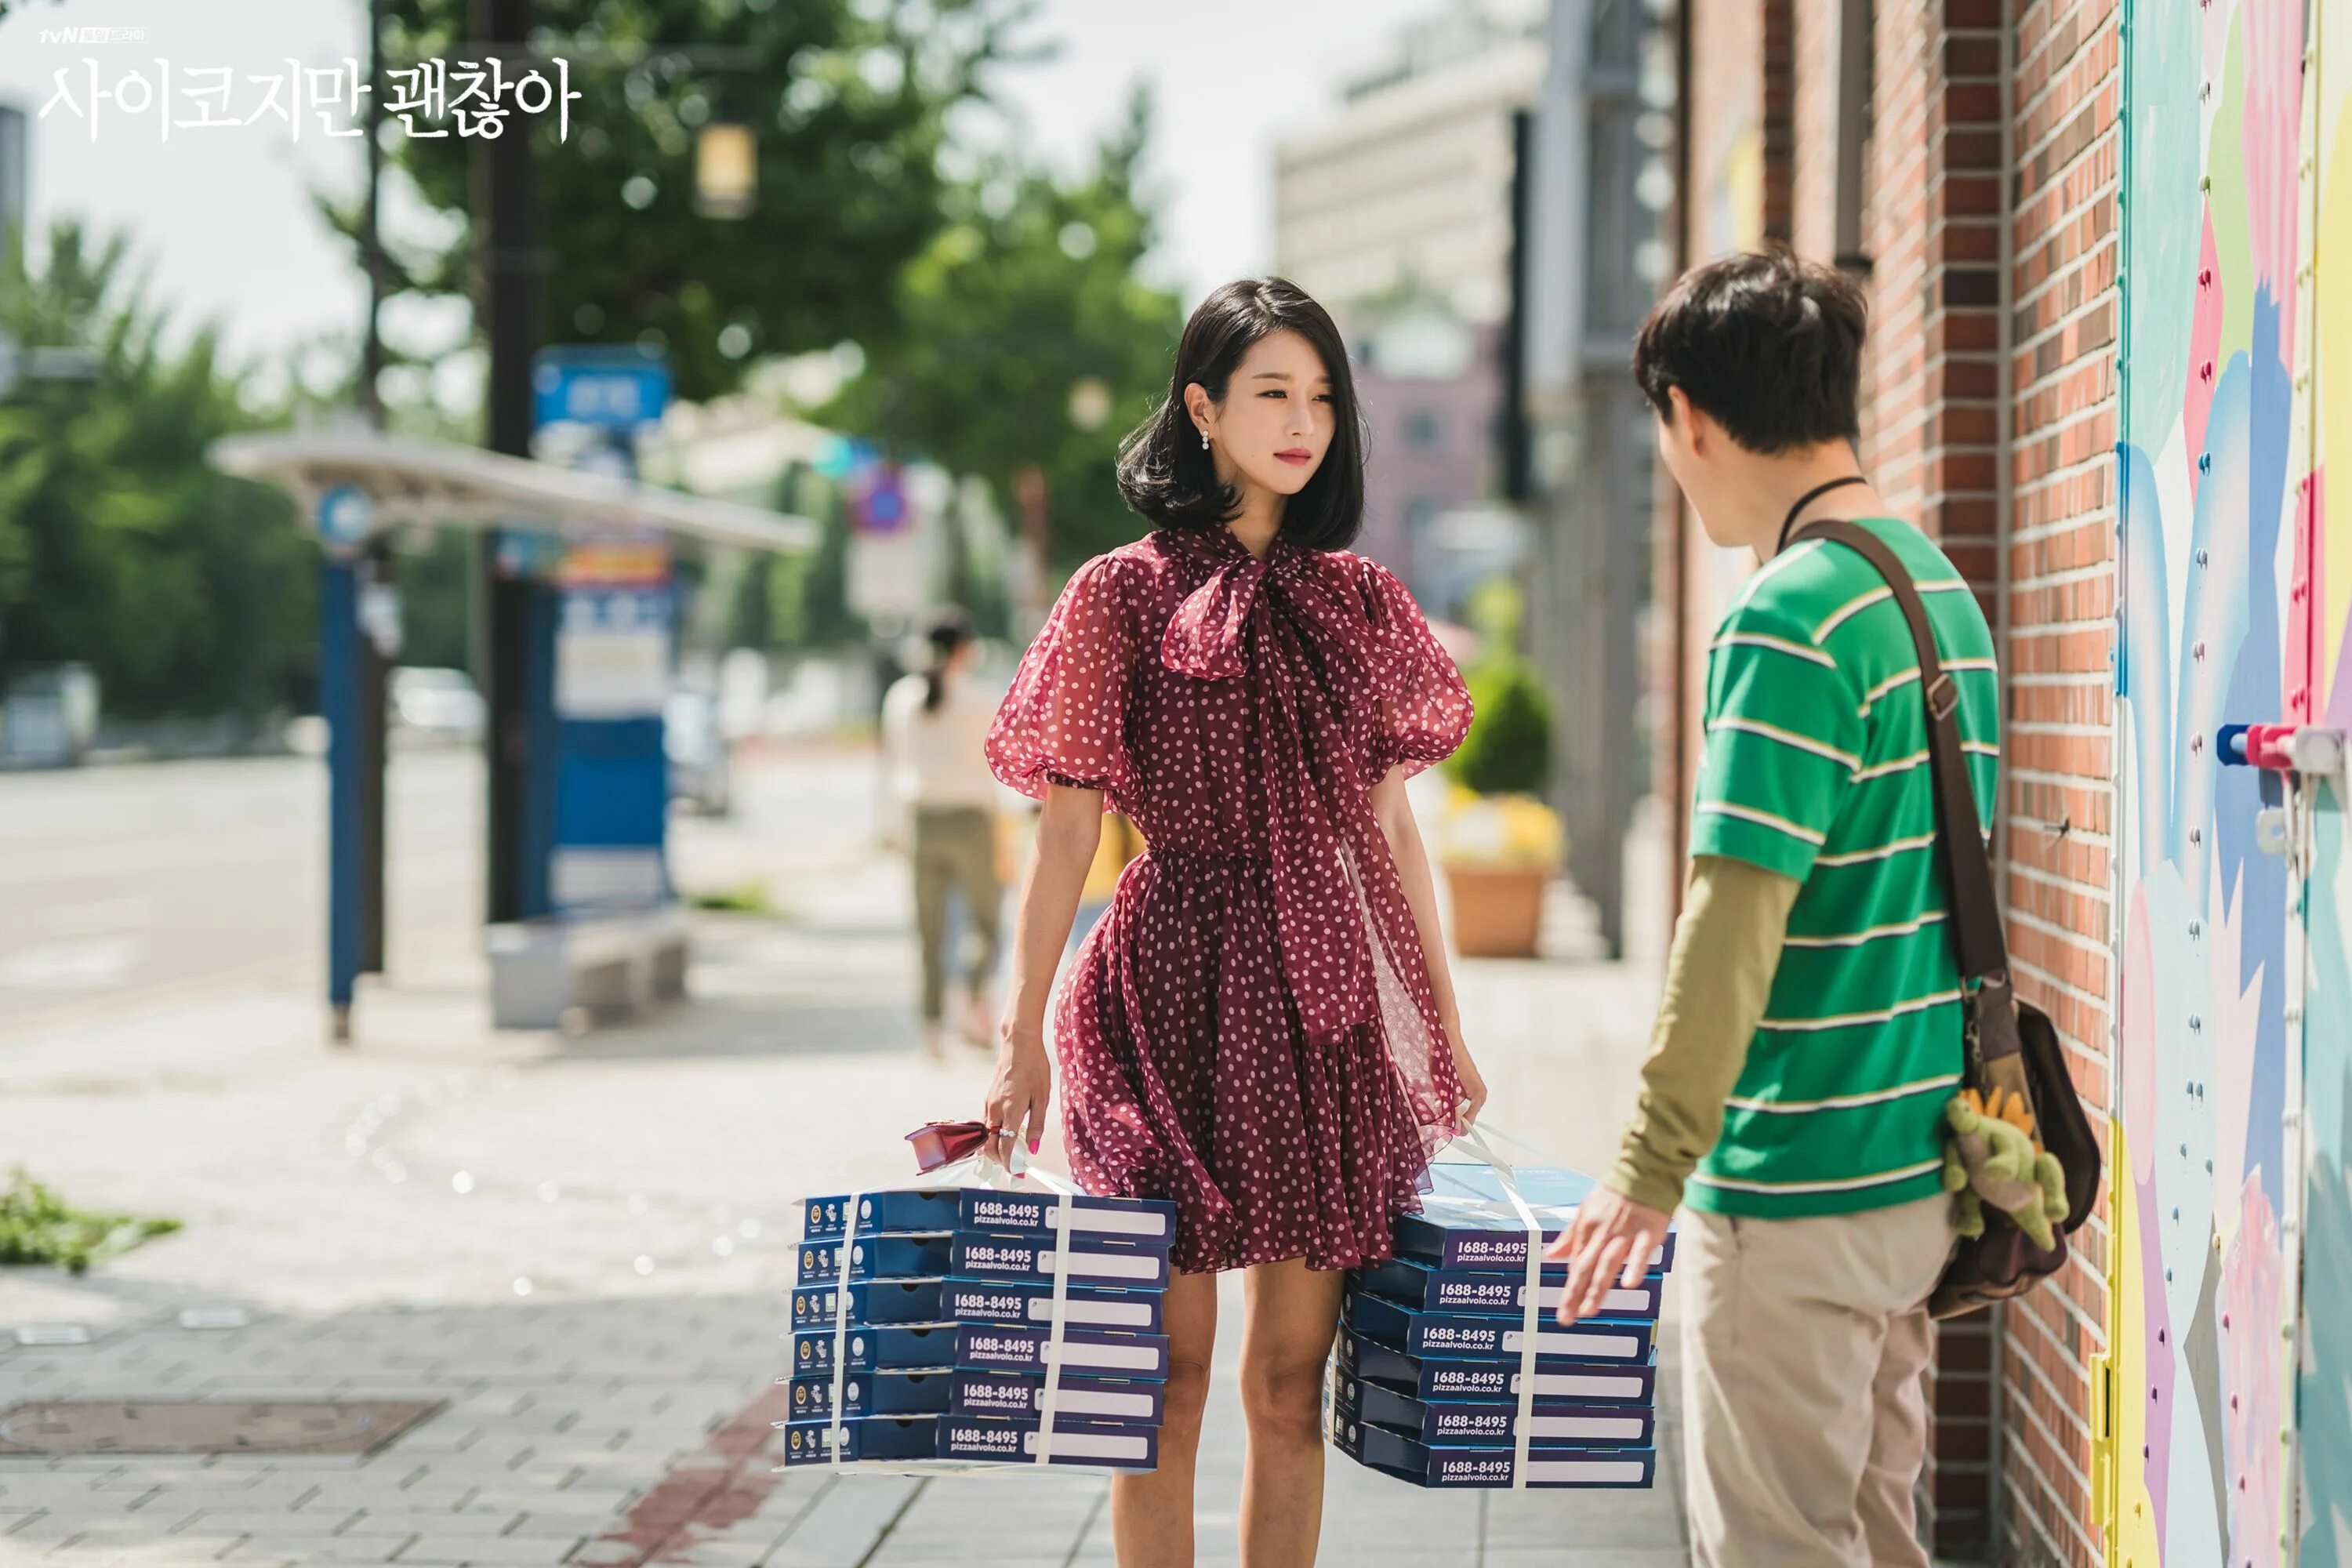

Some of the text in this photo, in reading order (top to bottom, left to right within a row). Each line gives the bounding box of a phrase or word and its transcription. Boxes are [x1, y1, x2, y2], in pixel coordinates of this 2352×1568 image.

[974, 1201, 1040, 1218] 1688-8495
[974, 1215, 1039, 1227] pizzaalvolo.co.kr
[1457, 1241, 1528, 1254] 1688-8495
[965, 1246, 1032, 1263] 1688-8495
[1457, 1254, 1526, 1263] pizzaalvolo.co.kr
[965, 1260, 1031, 1272] pizzaalvolo.co.kr
[1439, 1283, 1512, 1298] 1688-8495
[955, 1293, 1022, 1310] 1688-8495
[1439, 1296, 1509, 1305] pizzaalvolo.co.kr
[955, 1307, 1022, 1319] pizzaalvolo.co.kr
[1423, 1327, 1496, 1342] 1688-8495
[970, 1337, 1035, 1353] 1688-8495
[1422, 1340, 1494, 1350] pizzaalvolo.co.kr
[969, 1350, 1034, 1362] pizzaalvolo.co.kr
[1434, 1371, 1504, 1385] 1688-8495
[964, 1384, 1029, 1400] 1688-8495
[1432, 1384, 1503, 1392] pizzaalvolo.co.kr
[964, 1397, 1029, 1409] pizzaalvolo.co.kr
[1438, 1414, 1508, 1428] 1688-8495
[950, 1428, 1018, 1444] 1688-8495
[1436, 1428, 1505, 1436] pizzaalvolo.co.kr
[950, 1442, 1018, 1454] pizzaalvolo.co.kr
[1443, 1461, 1511, 1473] 1688-8495
[1441, 1474, 1509, 1483] pizzaalvolo.co.kr
